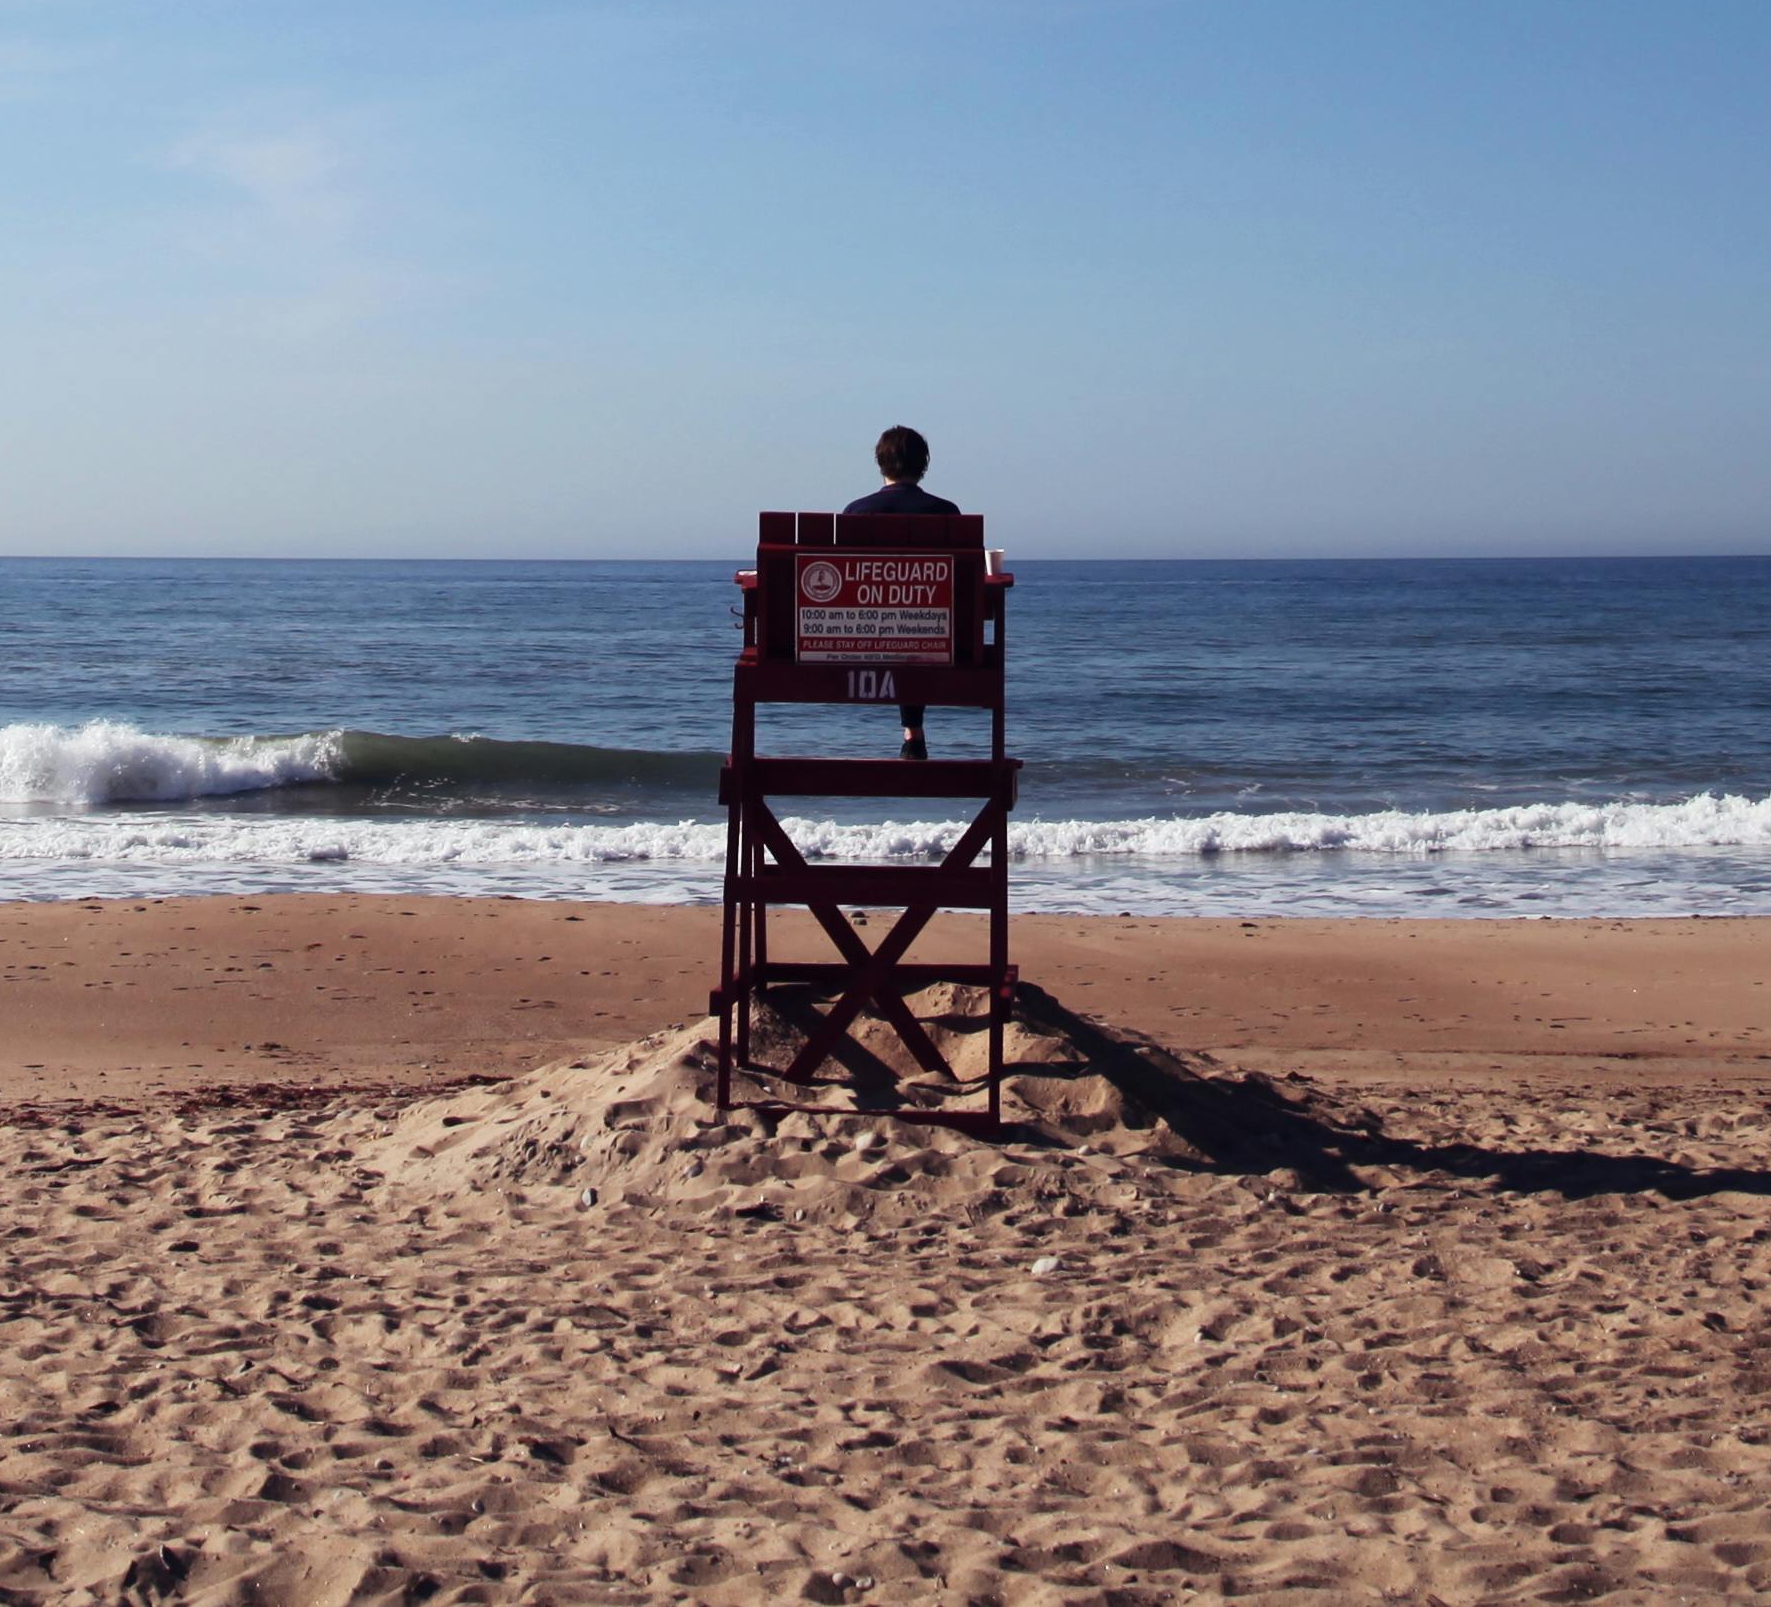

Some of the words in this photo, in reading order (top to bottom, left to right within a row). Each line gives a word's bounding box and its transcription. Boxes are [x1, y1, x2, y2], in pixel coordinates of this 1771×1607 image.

[845, 562, 948, 581] LIFEGUARD
[857, 585, 882, 604] ON
[888, 585, 937, 604] DUTY
[802, 609, 826, 620] 10:00
[828, 611, 843, 620] am
[846, 610, 856, 620] to
[858, 609, 878, 620] 6:00
[881, 611, 897, 623] pm
[899, 609, 947, 623] Weekdays
[803, 623, 824, 634] 9:00
[826, 625, 841, 634] am
[844, 624, 853, 634] to
[856, 623, 876, 634] 6:00
[878, 625, 894, 636] pm
[896, 623, 945, 634] Weekends
[803, 640, 834, 649] PLEASE
[835, 640, 855, 649] STAY
[856, 640, 872, 649] OFF
[874, 640, 919, 650] LIFEGUARD
[921, 641, 947, 650] CHAIR
[847, 670, 896, 699] 10A
